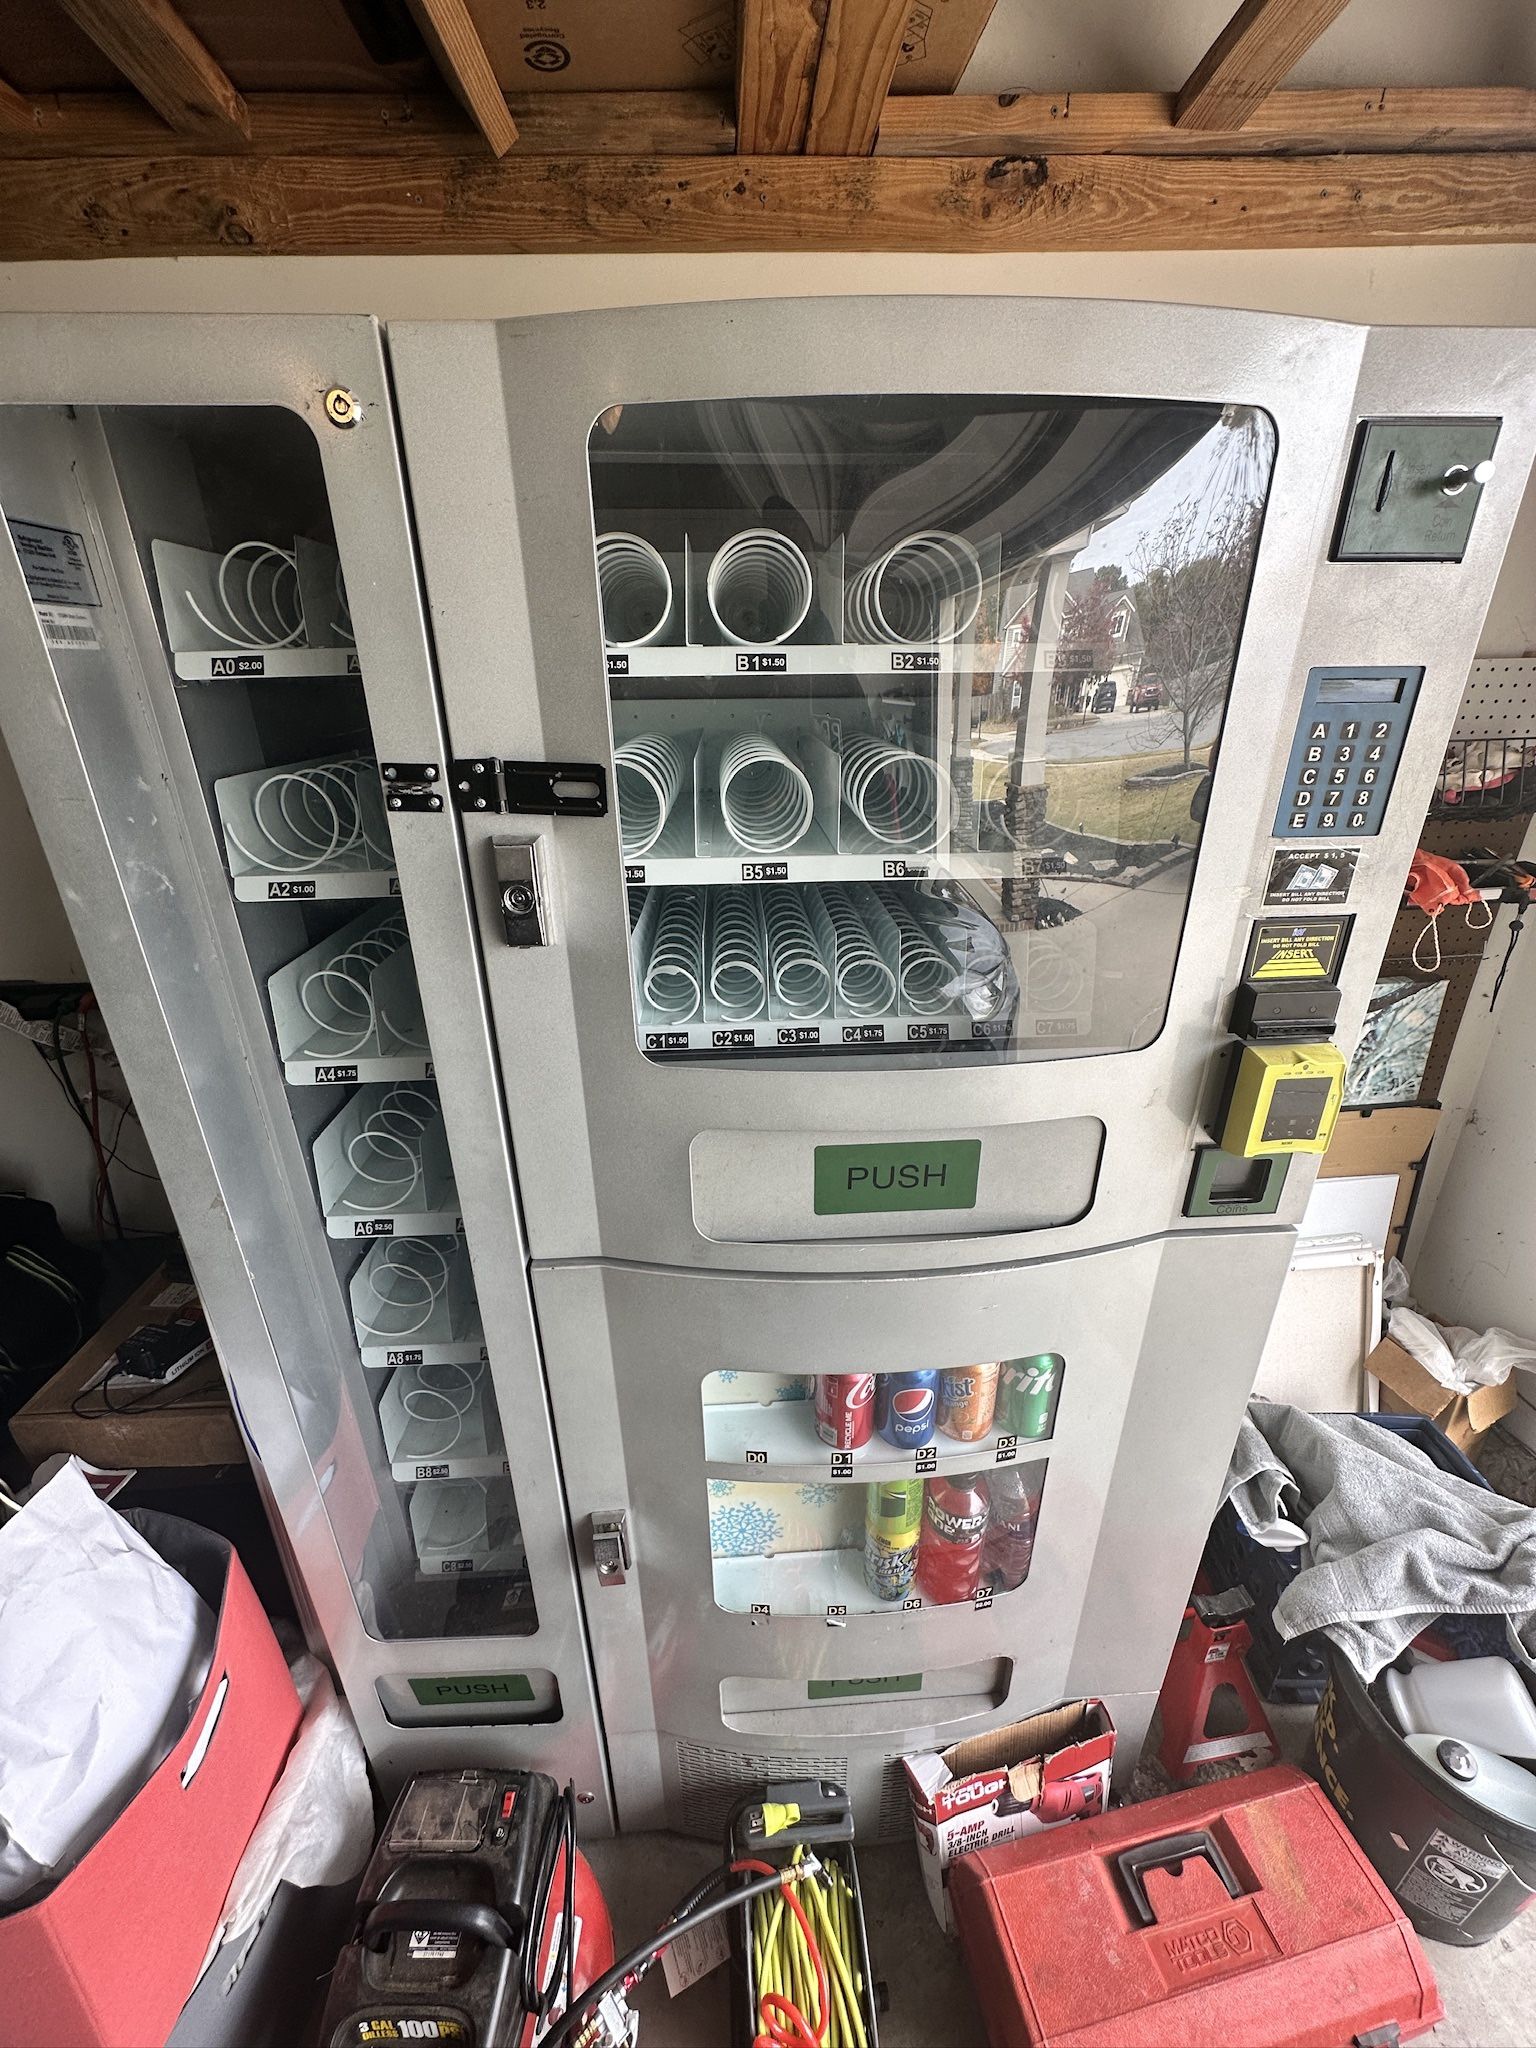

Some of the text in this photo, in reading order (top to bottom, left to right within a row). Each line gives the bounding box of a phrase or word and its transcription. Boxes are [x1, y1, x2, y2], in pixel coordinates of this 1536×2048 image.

[212, 659, 262, 675] A0 $2.00
[761, 658, 785, 667] $1.50
[891, 653, 939, 669] B2 $1.50
[1312, 722, 1388, 739] A 1 2
[1308, 746, 1381, 761] B 3 4
[1303, 768, 1375, 784] C 5 6
[1297, 790, 1369, 806] D 7 8
[1292, 813, 1306, 828] E
[1288, 852, 1321, 860] ACCEPT
[743, 865, 788, 880] B5 $1.50
[884, 862, 905, 877] B6
[269, 882, 315, 897] A2 $1.00
[1271, 948, 1315, 960] INSERT
[842, 1027, 883, 1042] C4 $1.75
[908, 1025, 948, 1039] C5 $1.75
[972, 1024, 992, 1036] C6
[1036, 1021, 1054, 1034] C7
[668, 1036, 688, 1044] $1.50
[712, 1031, 754, 1046] C2 $1.50
[778, 1029, 819, 1043] C3 $1.00
[316, 1067, 357, 1082] A4 $1.75
[847, 1163, 947, 1190] PUSH
[1216, 1203, 1249, 1215] Coins
[355, 1222, 393, 1236] A6 $2.50
[387, 1352, 422, 1365] A8 $1.75
[171, 1356, 194, 1376] LITHIUM
[844, 1411, 852, 1450] RECYCLE ME
[894, 1418, 930, 1435] pepsi
[999, 1437, 1016, 1448] D3
[747, 1452, 766, 1464] D0
[916, 1448, 936, 1460] D2
[997, 1451, 1016, 1460] $1.00
[417, 1467, 432, 1479] B8
[916, 1463, 936, 1471] $1.00
[443, 1561, 457, 1572] C8
[976, 1587, 993, 1599] D7
[752, 1605, 769, 1614] D4
[828, 1606, 846, 1615] D5
[903, 1599, 921, 1609] D6
[436, 1683, 509, 1696] PUSH
[947, 1820, 986, 1843] 5-AMP
[947, 1828, 989, 1851] 3/8-INCH
[948, 1825, 1016, 1858] ELECTRIC DRILL
[1441, 1834, 1504, 1869] WARNING
[1163, 1926, 1219, 1956] MATCO
[1169, 1941, 1230, 1973] TOOLS
[358, 2021, 370, 2033] 3
[397, 2020, 440, 2039] 100
[361, 2029, 400, 2041] OILLESS
